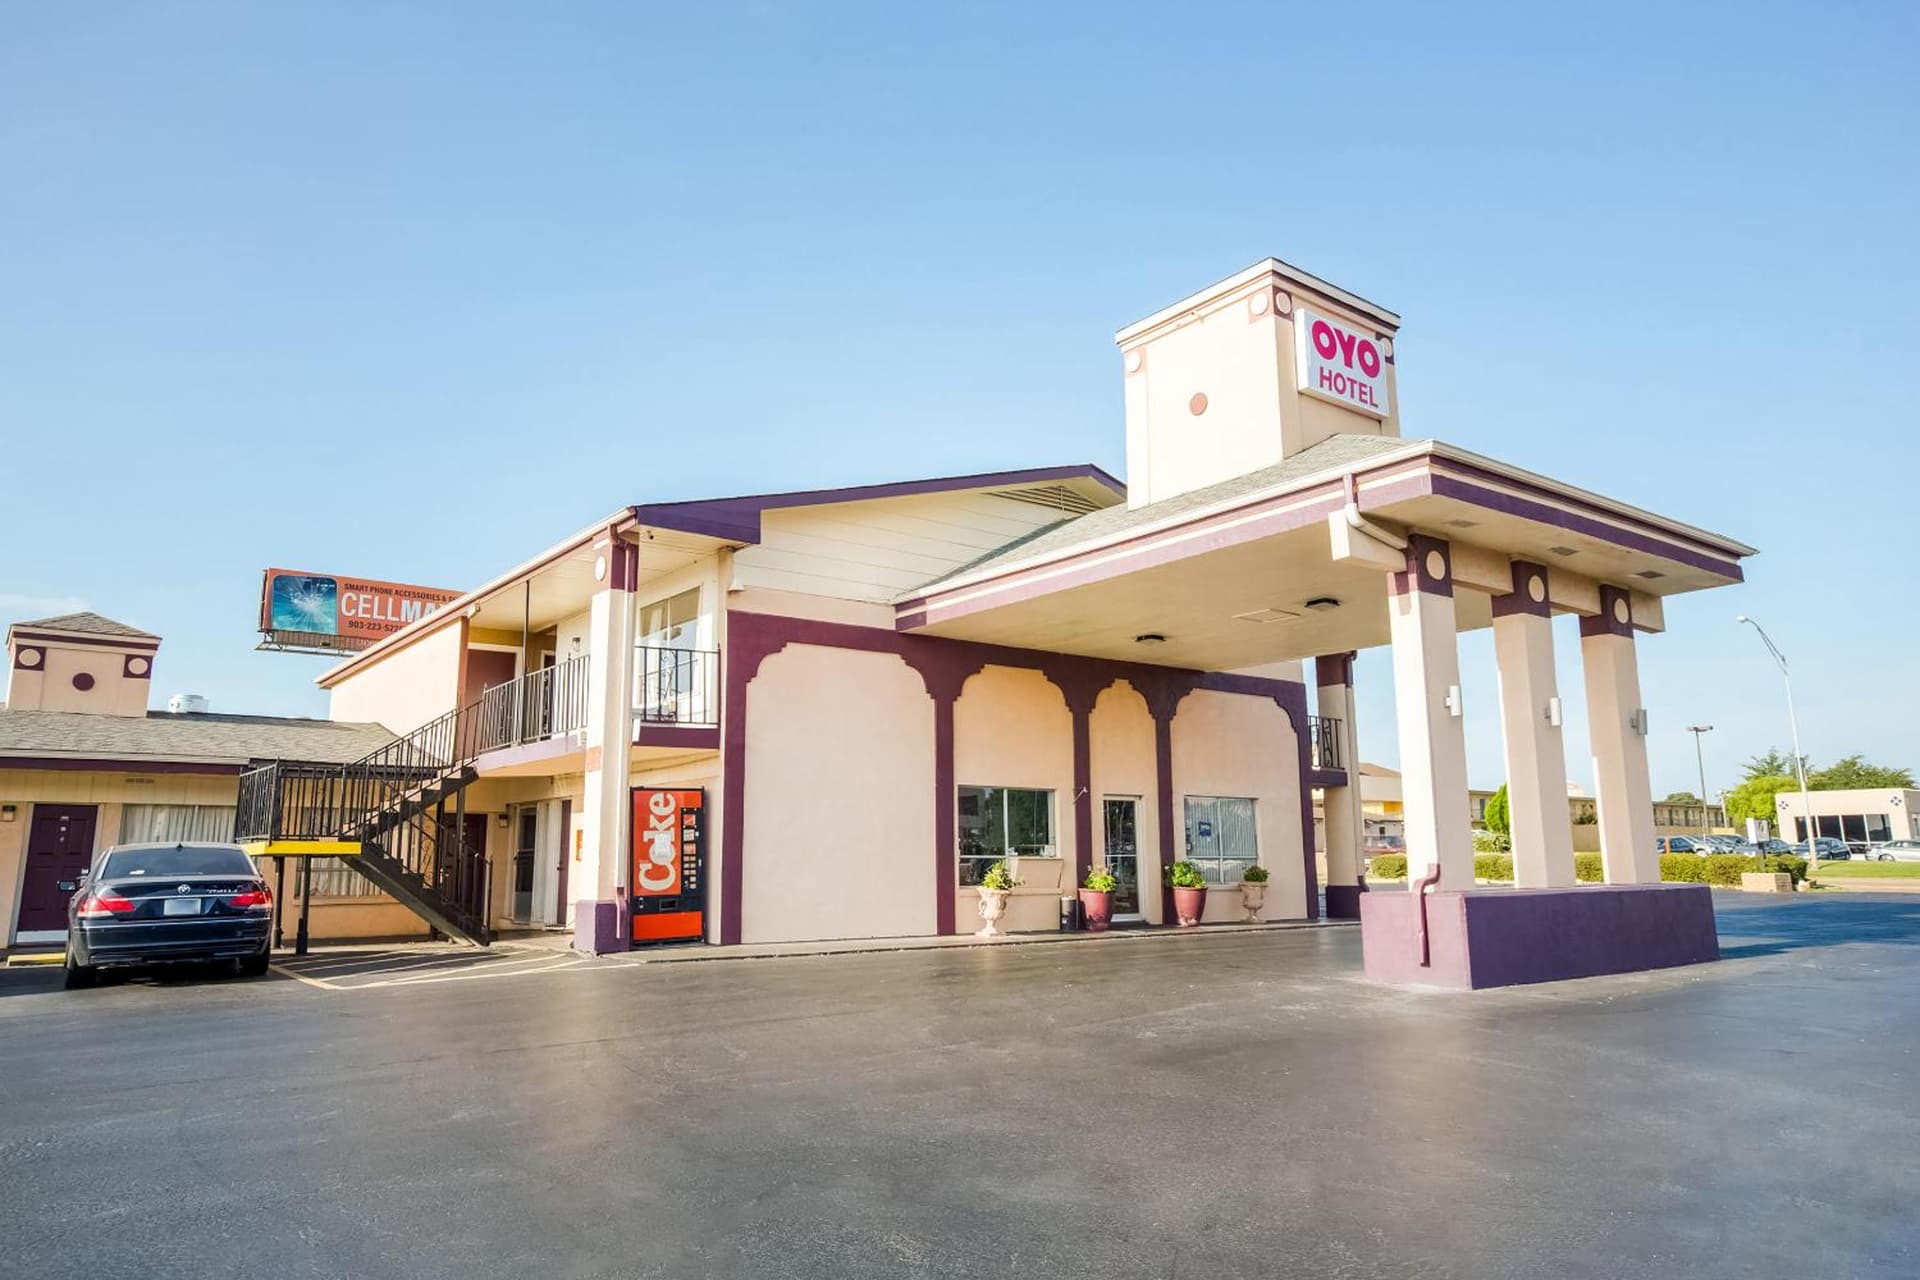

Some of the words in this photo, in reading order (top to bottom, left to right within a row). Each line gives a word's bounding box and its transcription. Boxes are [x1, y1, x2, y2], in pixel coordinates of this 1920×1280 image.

[1312, 320, 1380, 378] OYO
[1320, 366, 1378, 409] HOTEL
[341, 592, 442, 622] CELLMA
[344, 583, 368, 592] SMART
[370, 586, 393, 595] PHONE
[395, 589, 441, 601] ACCESSORIES
[638, 792, 676, 892] Coke
